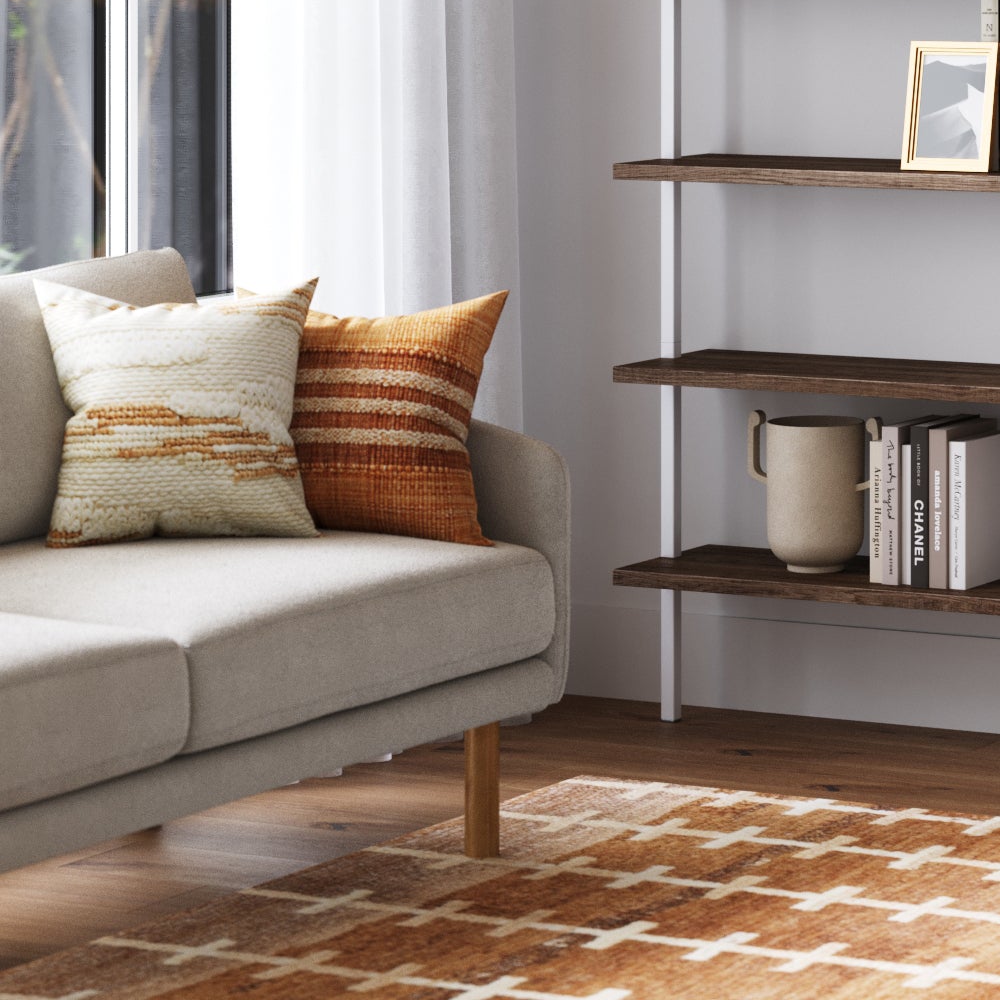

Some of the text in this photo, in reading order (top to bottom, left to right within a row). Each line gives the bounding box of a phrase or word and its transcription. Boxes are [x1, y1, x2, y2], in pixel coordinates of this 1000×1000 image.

[882, 440, 897, 520] The body beyond
[916, 478, 921, 486] OF
[952, 479, 962, 520] McCartney
[872, 507, 882, 559] Huffington
[914, 499, 924, 566] CHANEL
[934, 470, 942, 552] amanda lovelace
